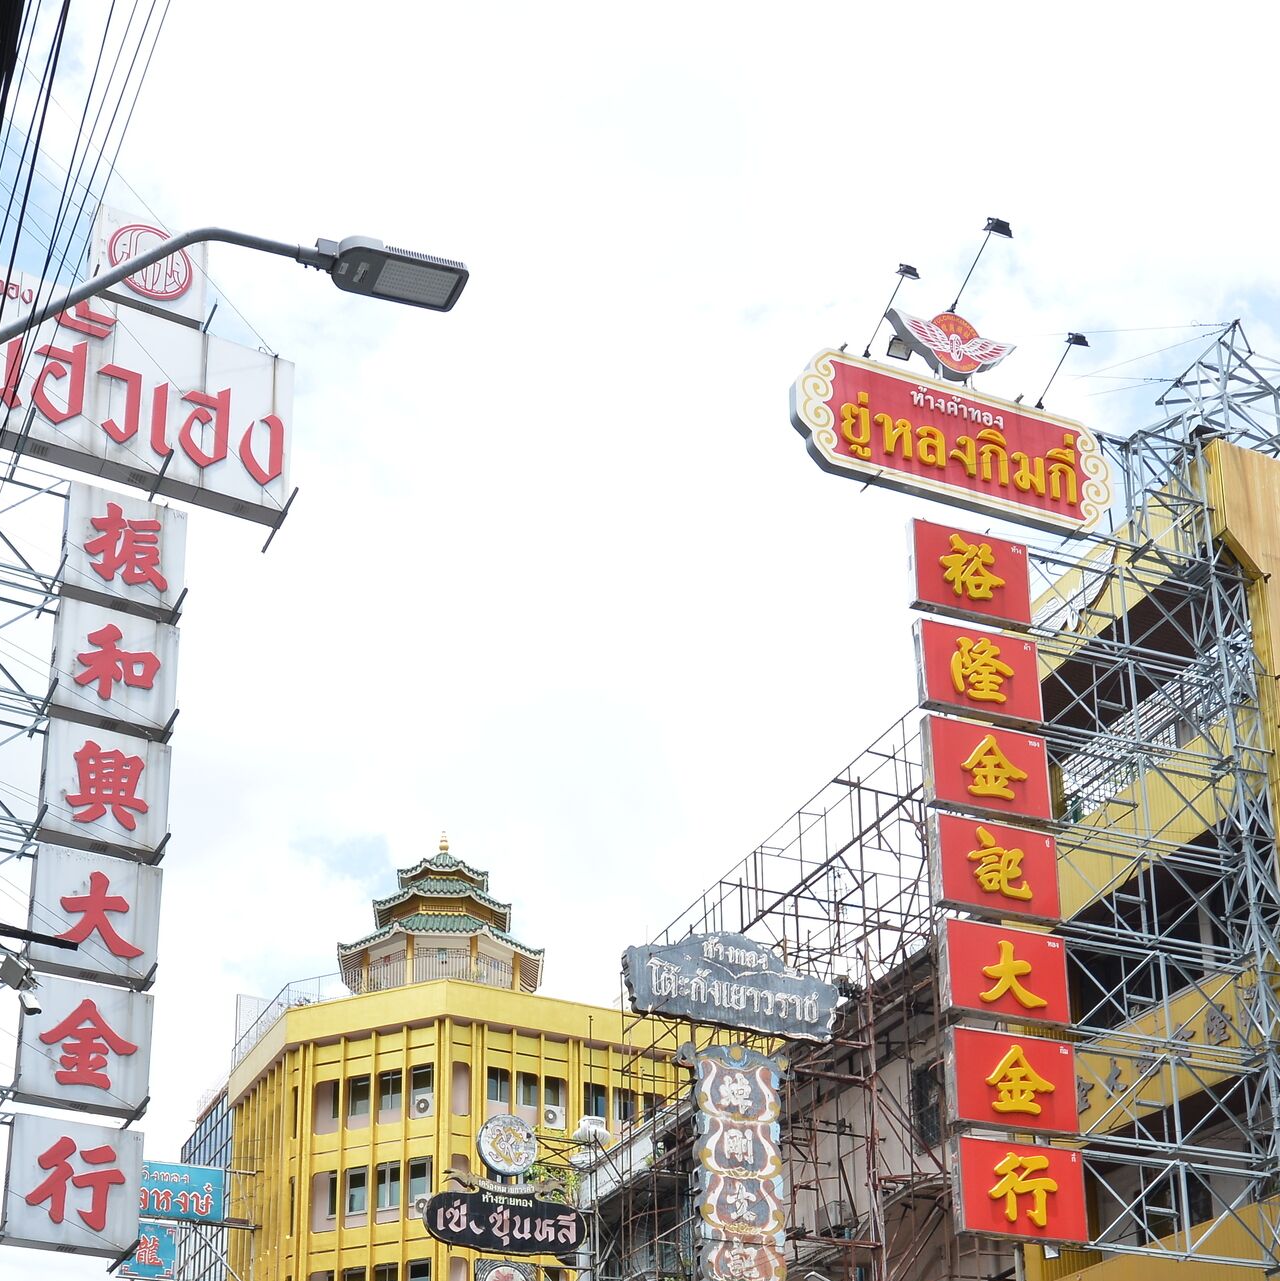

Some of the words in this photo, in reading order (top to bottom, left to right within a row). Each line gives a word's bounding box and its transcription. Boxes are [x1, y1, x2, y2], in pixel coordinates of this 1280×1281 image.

[911, 386, 1004, 430] ห้างค้าทอง
[840, 391, 1077, 505] ยู่หลงกิมกี่
[24, 502, 168, 1231] 振和興大金行
[939, 533, 1058, 1229] 裕隆金記大金行
[139, 1182, 215, 1217] งหงษ์
[489, 1204, 577, 1247] ซุ่นหลี
